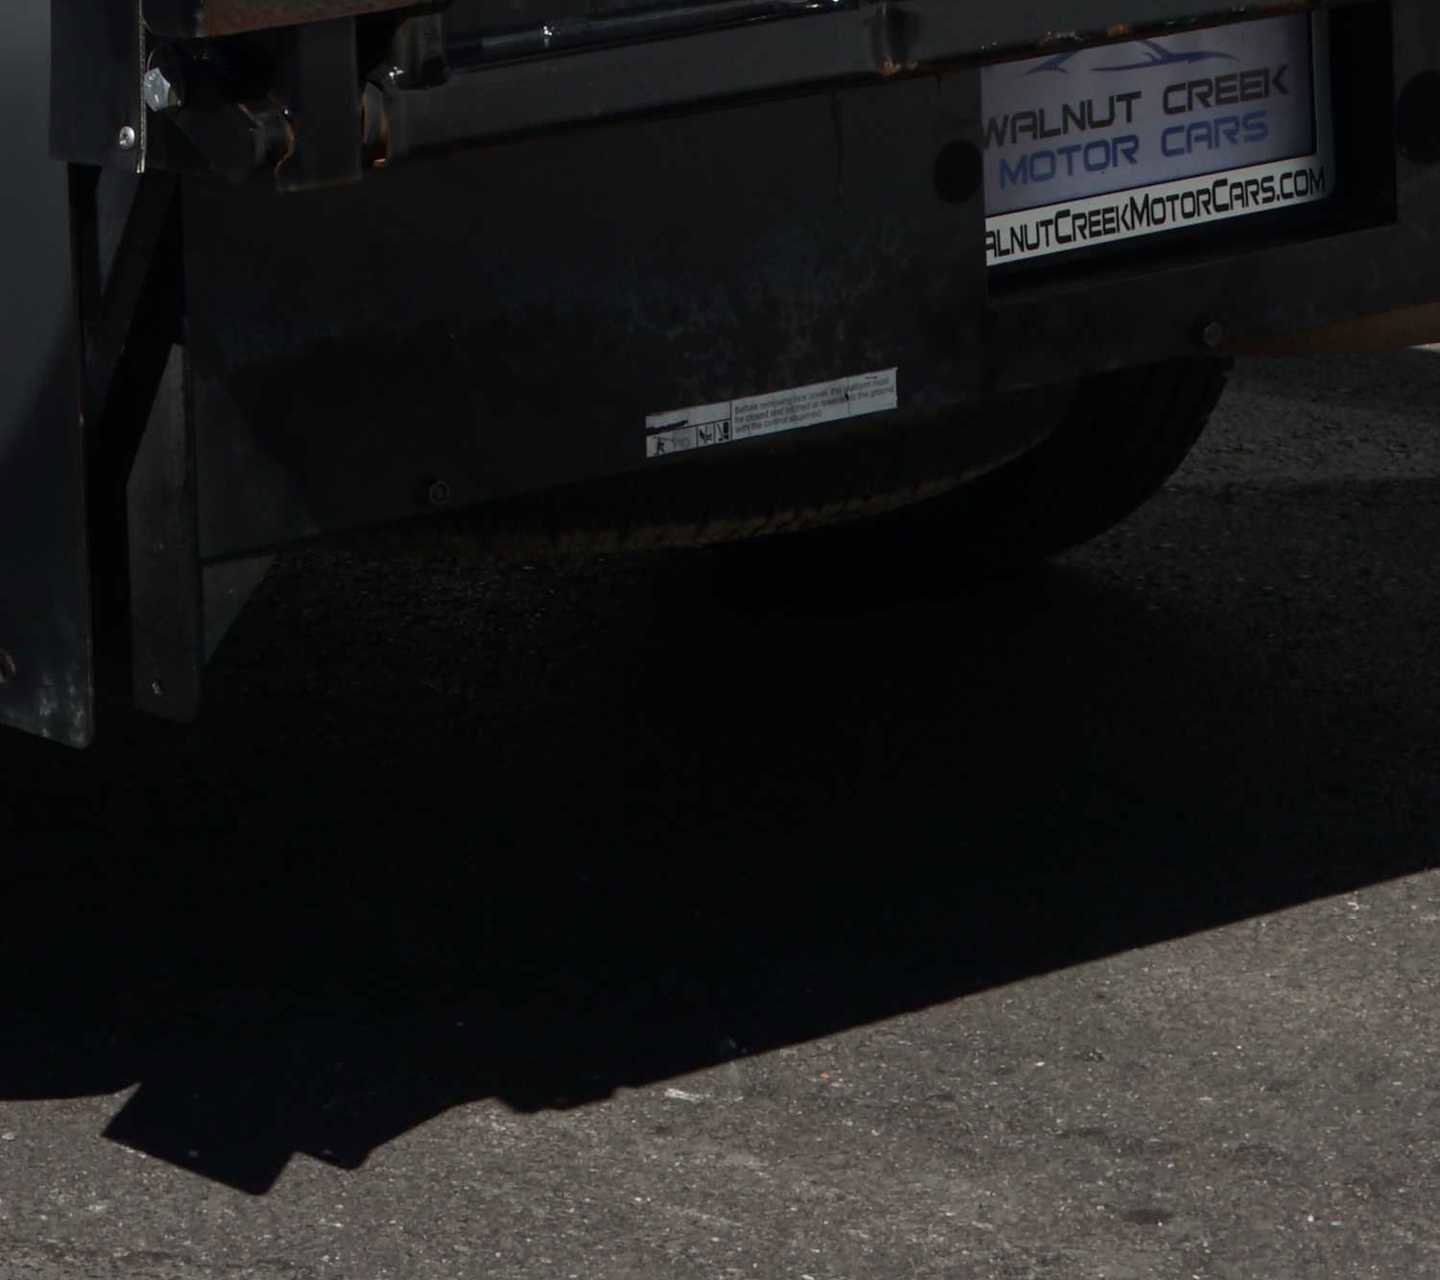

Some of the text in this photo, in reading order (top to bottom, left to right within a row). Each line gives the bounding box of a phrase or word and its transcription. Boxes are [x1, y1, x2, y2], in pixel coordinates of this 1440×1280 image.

[982, 64, 1289, 149] WALNUT CREEK
[1000, 109, 1270, 190] MOTOR CARS
